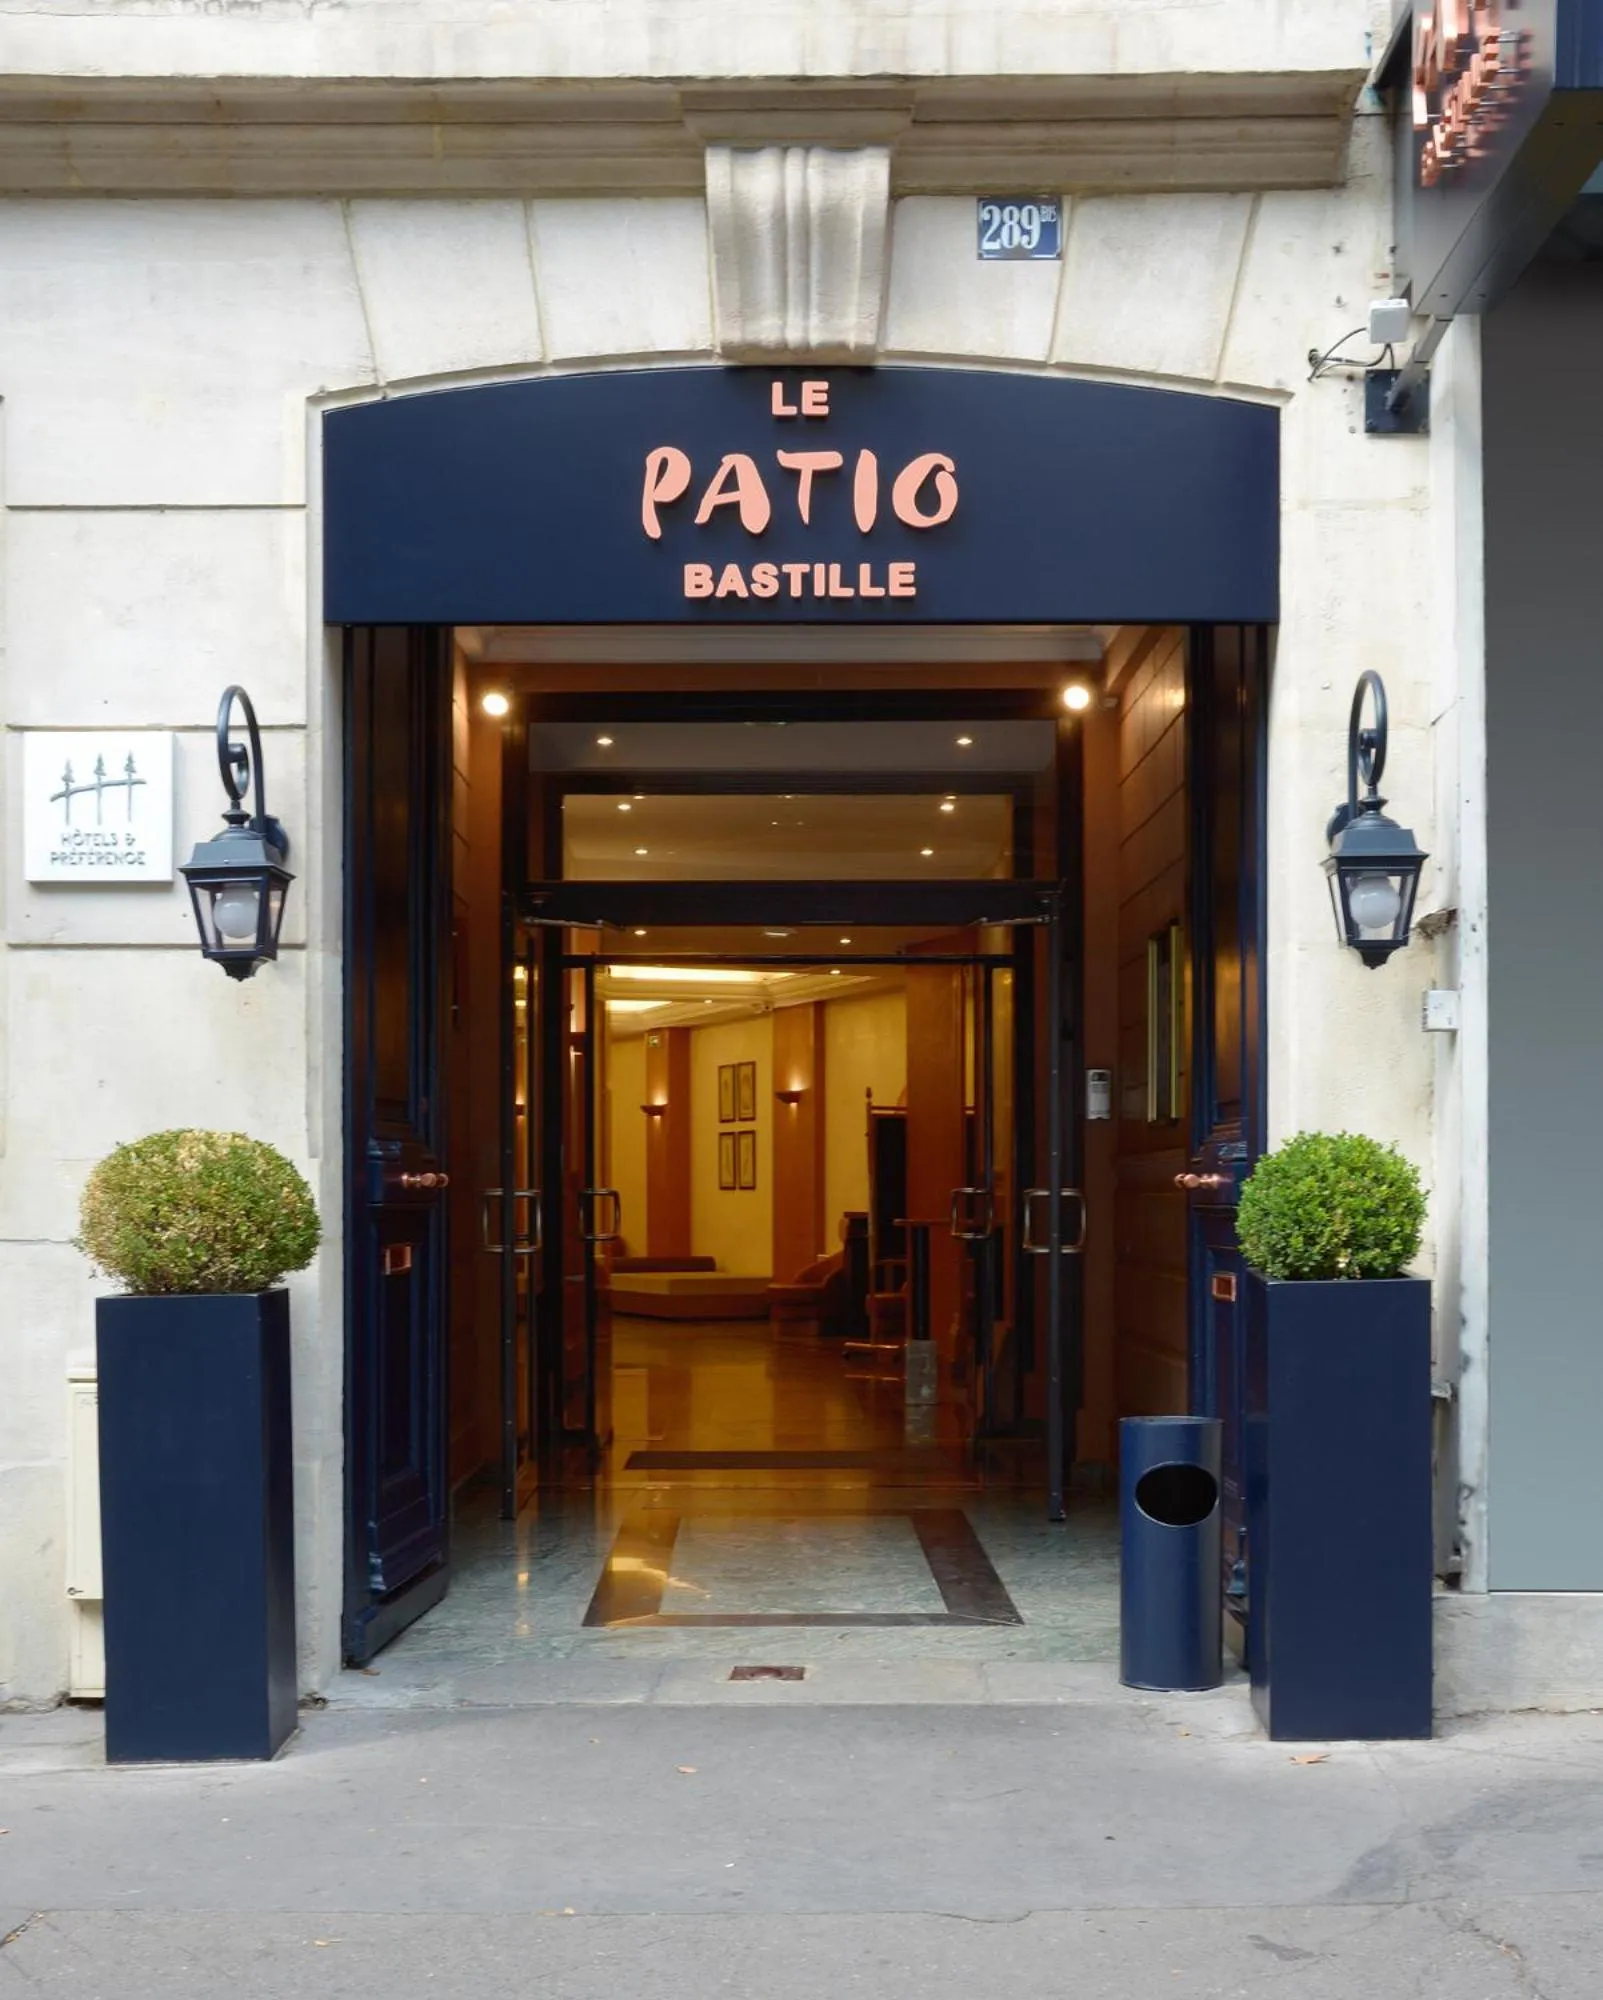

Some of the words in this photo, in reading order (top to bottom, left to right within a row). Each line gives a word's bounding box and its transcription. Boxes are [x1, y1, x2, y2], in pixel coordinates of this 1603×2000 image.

[981, 204, 1041, 250] 289
[771, 381, 830, 416] LE
[642, 446, 958, 539] PATIO
[684, 562, 917, 598] BASTILLE
